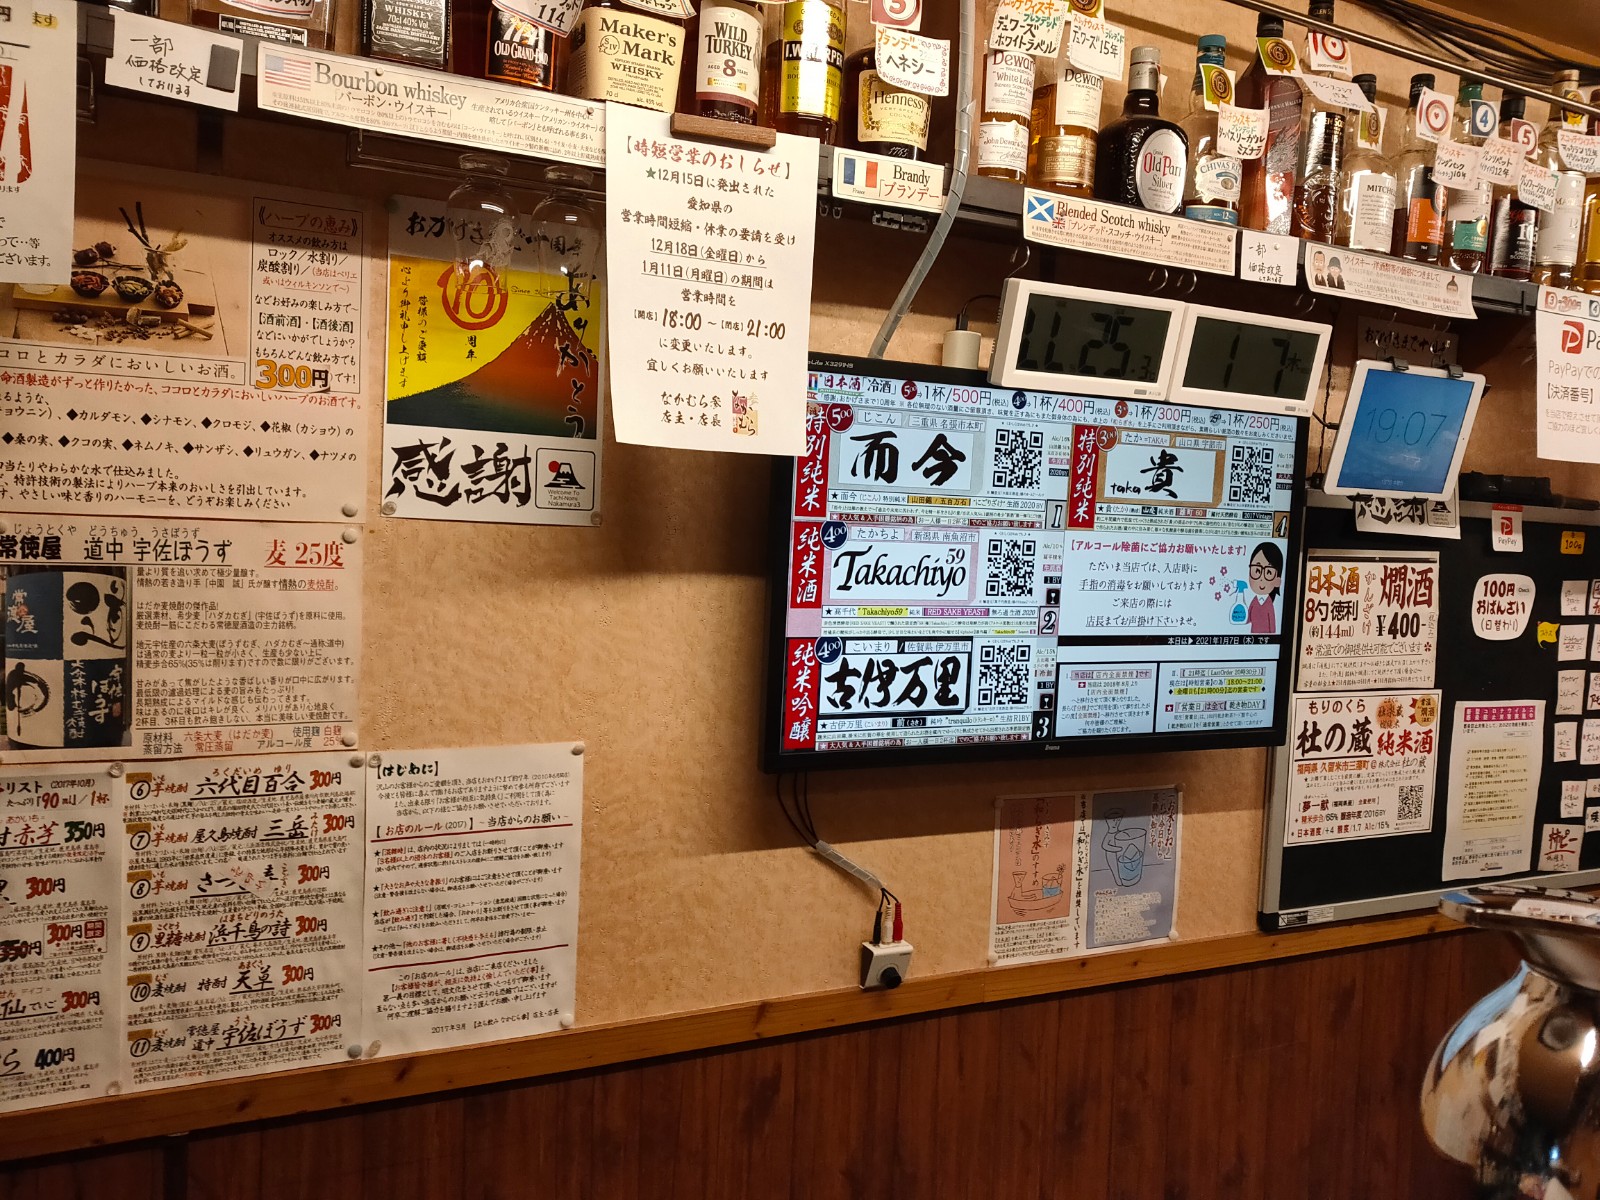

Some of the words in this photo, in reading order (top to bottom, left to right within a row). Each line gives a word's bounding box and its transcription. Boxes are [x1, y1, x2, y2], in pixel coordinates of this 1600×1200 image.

[385, 4, 434, 20] WHISKEY
[403, 17, 417, 27] 40%
[538, 4, 565, 28] 114
[599, 17, 677, 48] Maker's
[714, 22, 748, 43] WILD
[877, 29, 919, 50] ブランデー
[130, 36, 174, 54] 一部
[623, 41, 676, 67] Mark
[704, 34, 753, 61] TURKEY
[995, 33, 1057, 54] ホワイトラベル
[1099, 40, 1119, 59] 15年
[125, 55, 204, 86] 価格改定
[610, 61, 664, 80] WHISKY
[722, 59, 736, 77] 8
[886, 54, 936, 75] ヘネシー
[139, 77, 191, 98] しております
[314, 62, 398, 97] Bourbon
[403, 80, 467, 111] whiskey
[874, 91, 926, 113] Hennessy
[1480, 110, 1489, 128] 4
[1522, 127, 1532, 146] 5
[627, 135, 791, 180] 【時短営業のおしらせ】
[1143, 152, 1163, 173] Old
[1162, 155, 1183, 178] Parr
[1200, 161, 1231, 174] CHIVAS
[893, 164, 930, 185] Brandy
[1152, 174, 1173, 190] Silver
[852, 187, 866, 196] France
[687, 196, 733, 214] 愛知県の
[1222, 211, 1230, 220] 12
[620, 208, 796, 246] 営業時間短縮・休業の要請を受け
[1057, 200, 1098, 221] Blended
[1100, 209, 1135, 229] Scotch
[1138, 217, 1171, 238] whisky
[268, 232, 347, 251] オススメの飲み方は
[651, 237, 766, 265] 12月18日(金曜日)から
[1249, 244, 1267, 258] 一部
[1249, 261, 1284, 277] 価格改定
[681, 288, 736, 307] 営業時間を
[662, 308, 702, 331] 18:00
[746, 319, 786, 340] 21:00
[256, 329, 356, 349] などにいかがでしょうか?
[465, 335, 478, 362] 周年
[659, 337, 753, 360] に変更いたします。
[255, 346, 356, 366] もちろんどんな飲み方でも
[255, 359, 330, 391] 300円
[646, 358, 769, 382] 宜しくお願いいたします
[1547, 382, 1594, 404] 【決済番号】
[863, 411, 897, 425] じこん
[911, 416, 937, 428] 三重県
[1366, 406, 1448, 447] 19:07
[1124, 432, 1143, 443] たか
[319, 450, 357, 462] ナツメの
[849, 431, 967, 487] 而今
[385, 437, 532, 509] 感謝
[1073, 428, 1096, 524] 特別純米
[1140, 448, 1184, 499] 貴
[1110, 481, 1141, 496] taka
[548, 501, 581, 509] Nakamura3
[13, 523, 77, 536] じょうとくや
[88, 525, 139, 538] どうちゅう
[151, 526, 200, 540] うさぼうず
[856, 528, 900, 540] たかちよ
[914, 531, 940, 541] 新潟県
[1275, 515, 1288, 538] 4
[0, 535, 62, 560] 常徳屋
[84, 539, 125, 562] 道中
[133, 539, 233, 563] 宇佐ぼうず
[1070, 538, 1247, 556] 【アルコール除菌にご協力お願いいたします】
[1498, 537, 1517, 546] PayPay
[265, 539, 287, 567] 麦
[295, 541, 344, 567] 25度
[796, 528, 821, 604] 純米酒
[833, 545, 967, 598] Takachiyo
[945, 547, 966, 565] 59
[1088, 561, 1198, 575] ただいま当店では、入店時に
[1079, 578, 1203, 592] 手指の消毒をお願いしております
[1308, 564, 1361, 598] 日本酒
[1379, 564, 1435, 610] 燗酒
[1483, 580, 1516, 598] 100円
[927, 608, 939, 616] RED
[941, 608, 961, 616] SAKE
[963, 608, 987, 616] YEAST
[1111, 597, 1173, 609] ご来店の際には
[1476, 600, 1526, 615] おばんざい
[1042, 608, 1057, 634] 2
[1085, 615, 1199, 628] 店長までお声掛け下さいませ。
[1480, 618, 1519, 632] (日替わり)
[852, 642, 892, 652] こいまり
[907, 641, 934, 651] 佐賀県
[935, 641, 970, 651] 伊万里市
[1167, 635, 1188, 645] 本日は
[1257, 636, 1271, 645] です
[1314, 641, 1423, 658] 常温での御提供も可能でございます
[788, 642, 815, 742] 純米吟醸
[824, 655, 962, 712] 古伊万里
[1308, 698, 1367, 716] もりのくら
[143, 732, 174, 743] 原材料
[184, 730, 223, 742] 六条大麦
[1036, 716, 1049, 739] 3
[1296, 716, 1374, 758] 杜の蔵
[1376, 728, 1435, 757] 純米酒
[143, 742, 183, 755] 蒸留方法
[195, 740, 234, 752] 常圧蒸留
[257, 737, 313, 749] アルコール度
[212, 766, 262, 777] ろくだいめ
[377, 761, 439, 780] 【はじめに】
[1297, 762, 1319, 775] 福岡県
[151, 782, 188, 797] 芋焼酎
[195, 770, 306, 797] 六代目百合
[309, 769, 342, 791] 300円
[1301, 798, 1330, 813] 夢一献
[151, 830, 188, 848] 芋焼酎
[189, 825, 259, 844] 屋久島焼酎
[262, 814, 310, 840] 三岳
[323, 813, 355, 835] 300円
[487, 813, 561, 828] 当店からのお願い
[64, 821, 105, 844] 350円
[26, 877, 67, 899] 300円
[151, 878, 188, 897] 芋焼酎
[298, 863, 331, 886] 300円
[47, 922, 83, 946] 300円
[151, 931, 207, 948] 黒糖焼酎
[208, 918, 293, 946] 浜千鳥の詩
[296, 915, 328, 937] 300円
[151, 983, 187, 998] 麦焼酎
[232, 965, 274, 991] 天草
[282, 965, 315, 986] 300円
[61, 991, 100, 1013] 300円
[151, 1037, 187, 1052] 麦焼酎
[221, 1014, 309, 1048] 宇佐ぼうず
[310, 1013, 342, 1034] 300円
[34, 1047, 76, 1070] 400円
